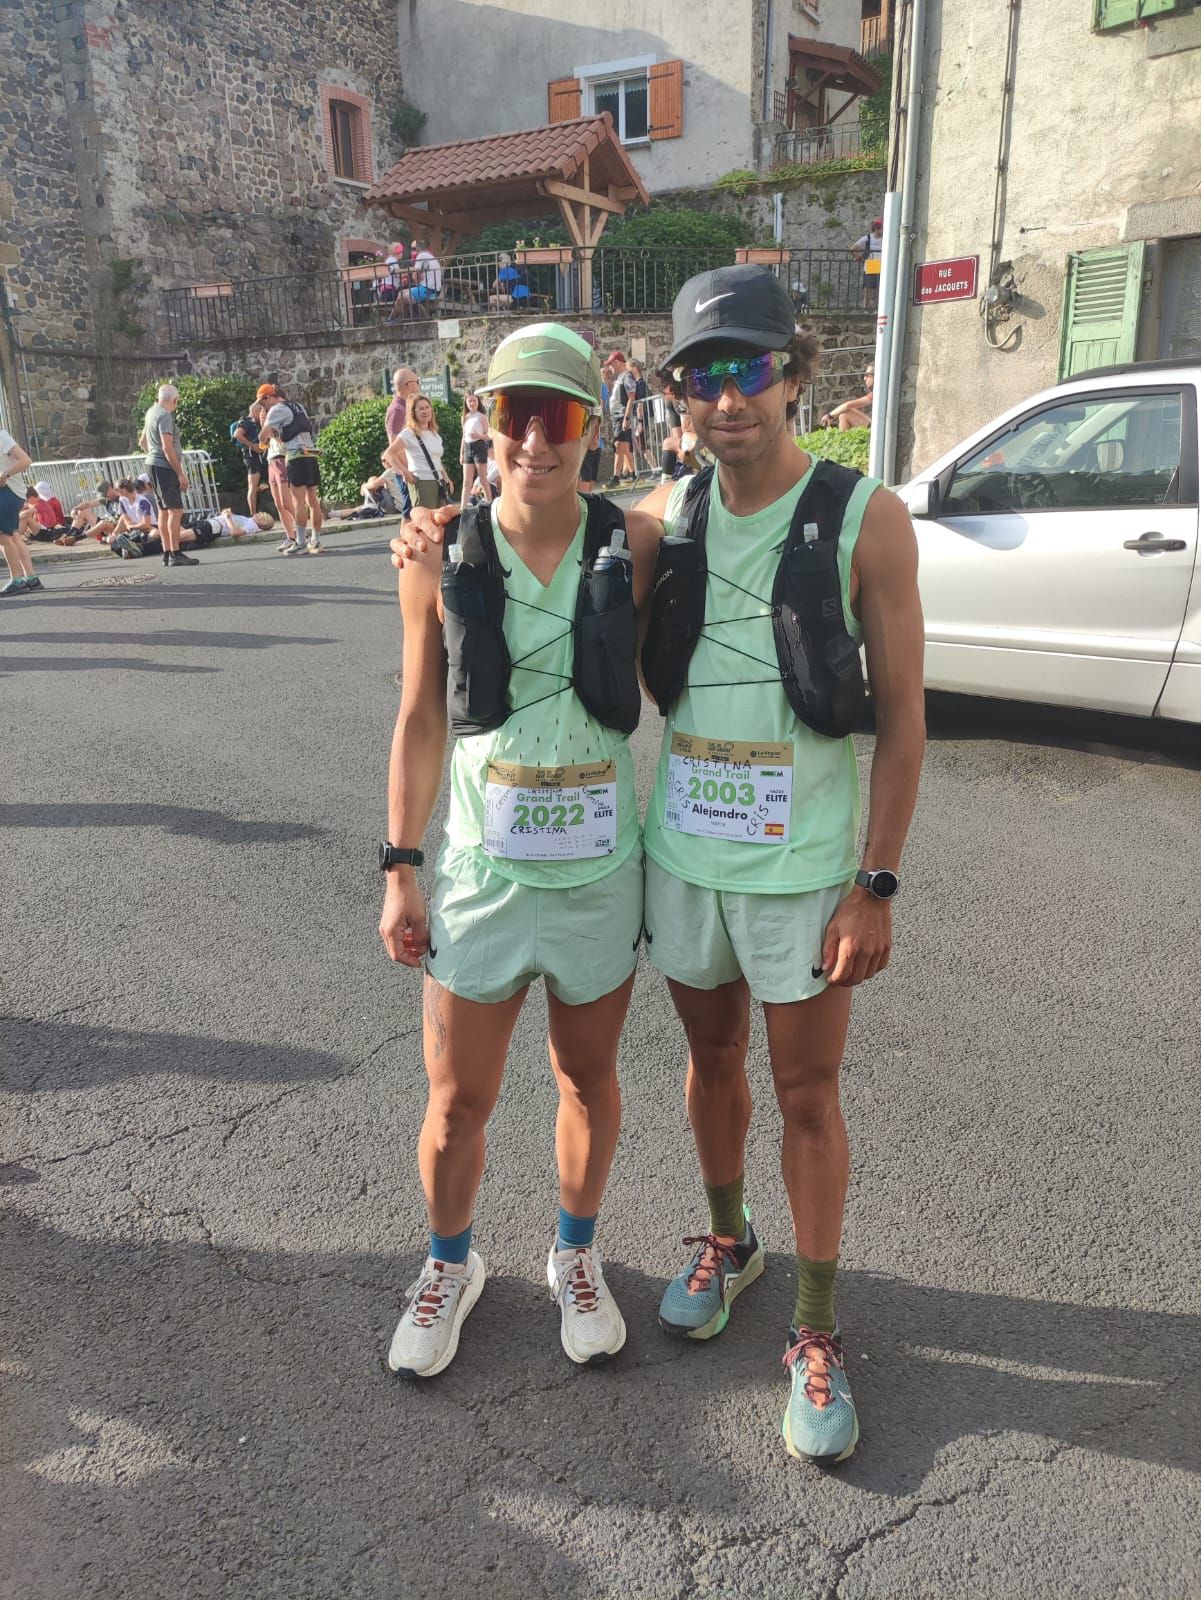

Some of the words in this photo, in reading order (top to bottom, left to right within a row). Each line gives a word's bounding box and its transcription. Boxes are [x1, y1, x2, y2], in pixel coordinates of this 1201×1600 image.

[938, 268, 952, 278] RUE
[921, 286, 933, 295] des
[934, 281, 968, 293] JACQUETS
[682, 755, 752, 771] CRISTINA
[692, 766, 723, 778] Grand
[725, 769, 750, 780] Trail
[516, 793, 553, 803] Grand
[556, 792, 580, 802] Trail
[687, 776, 756, 807] 2003
[765, 794, 788, 803] ELITE
[513, 804, 585, 827] 2022
[594, 809, 613, 819] ELITE
[692, 804, 748, 820] Alejandro
[746, 804, 769, 836] CRIS
[510, 826, 567, 835] CRISTINA
